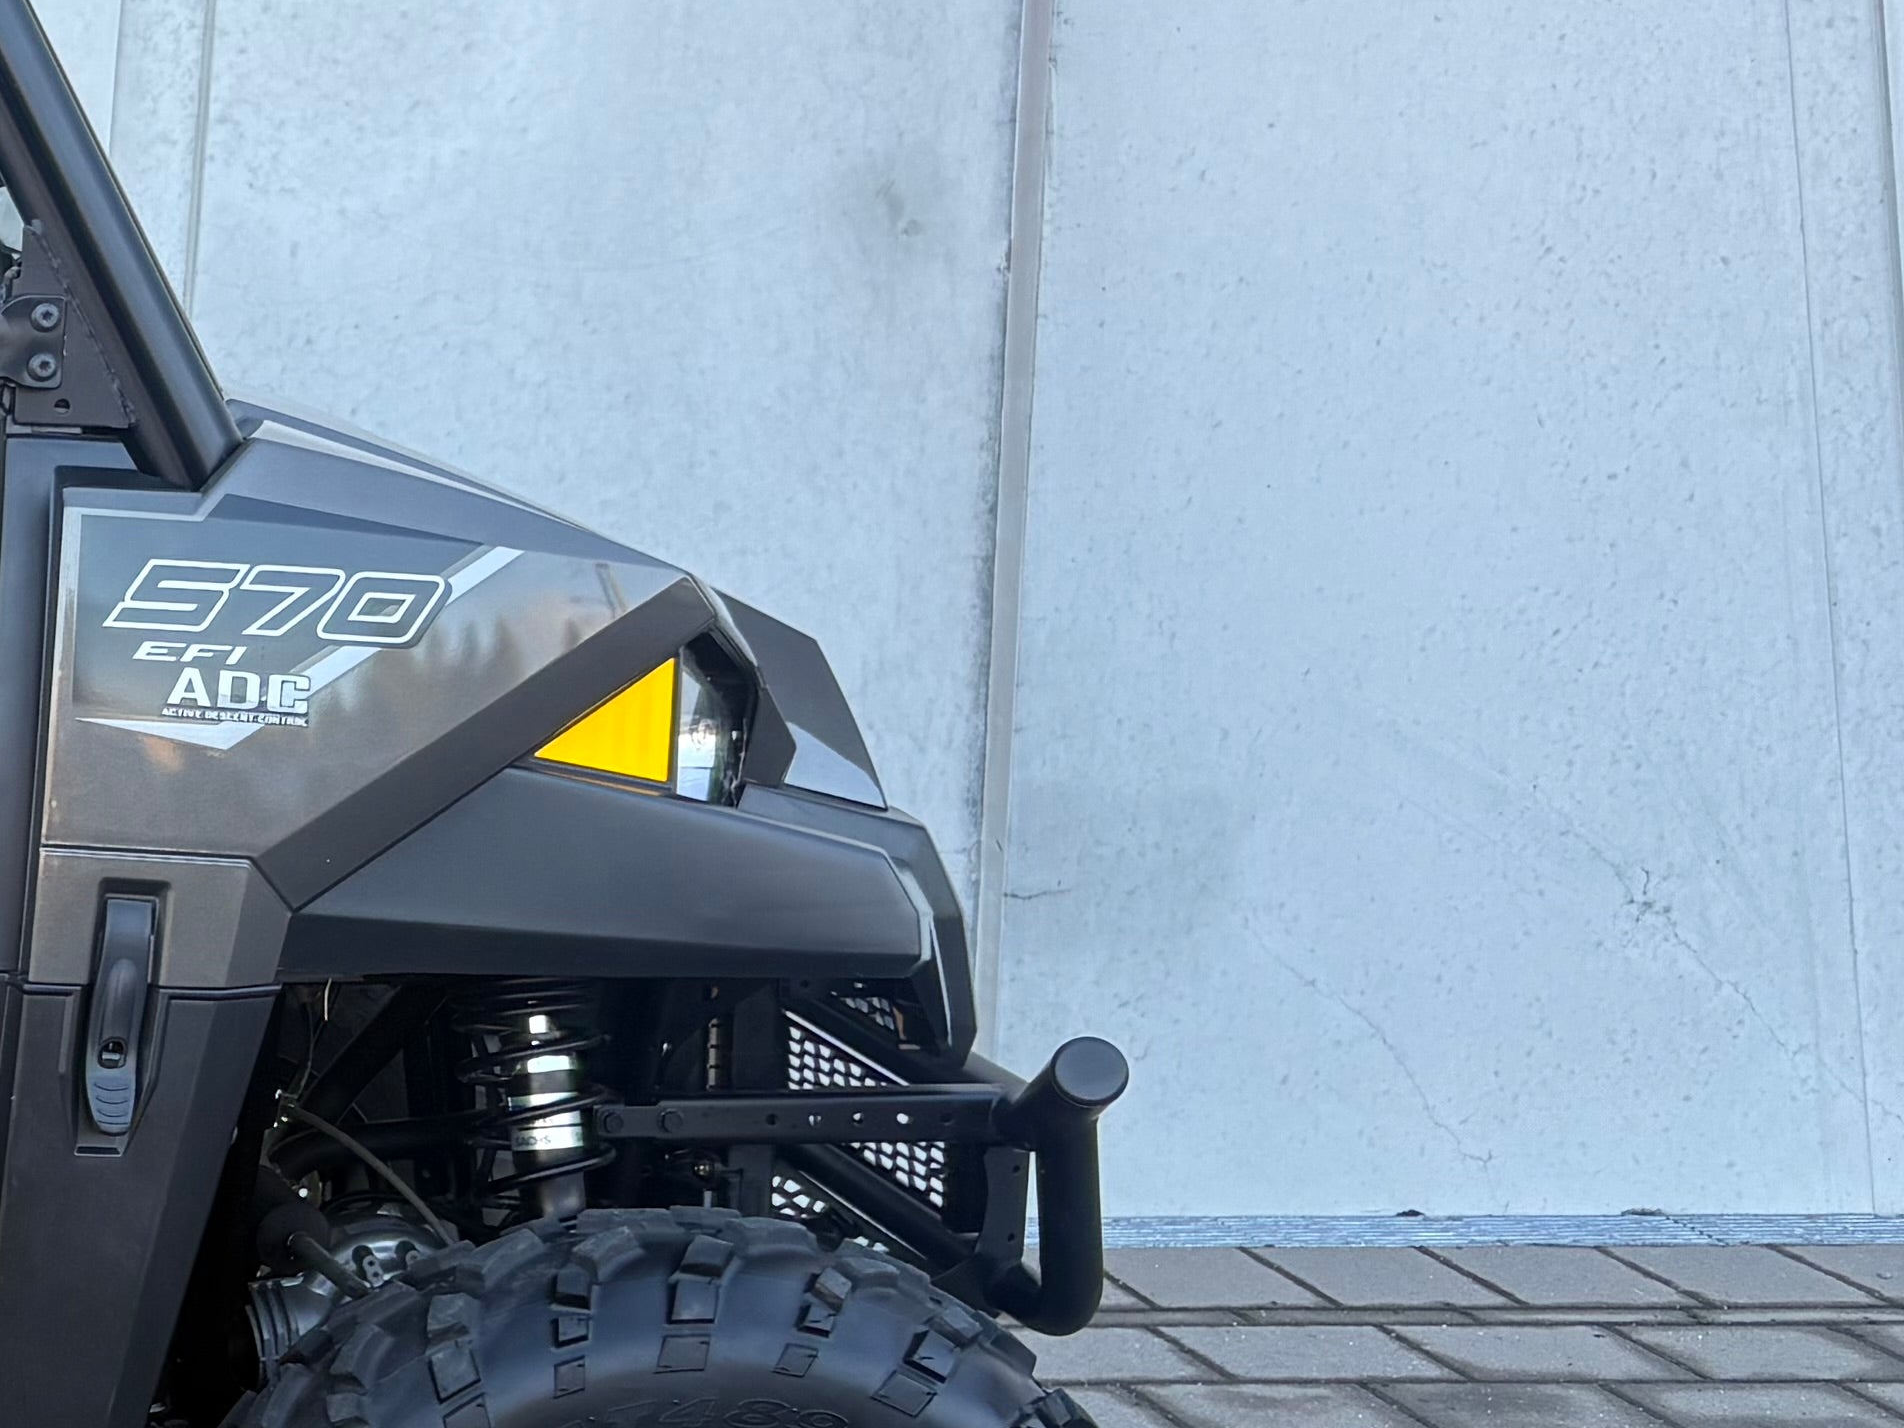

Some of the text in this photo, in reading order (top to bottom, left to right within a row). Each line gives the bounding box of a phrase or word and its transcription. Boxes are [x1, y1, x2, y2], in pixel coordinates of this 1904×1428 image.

[102, 558, 449, 644] 570
[132, 640, 248, 666] EFI
[166, 667, 312, 715] ADC
